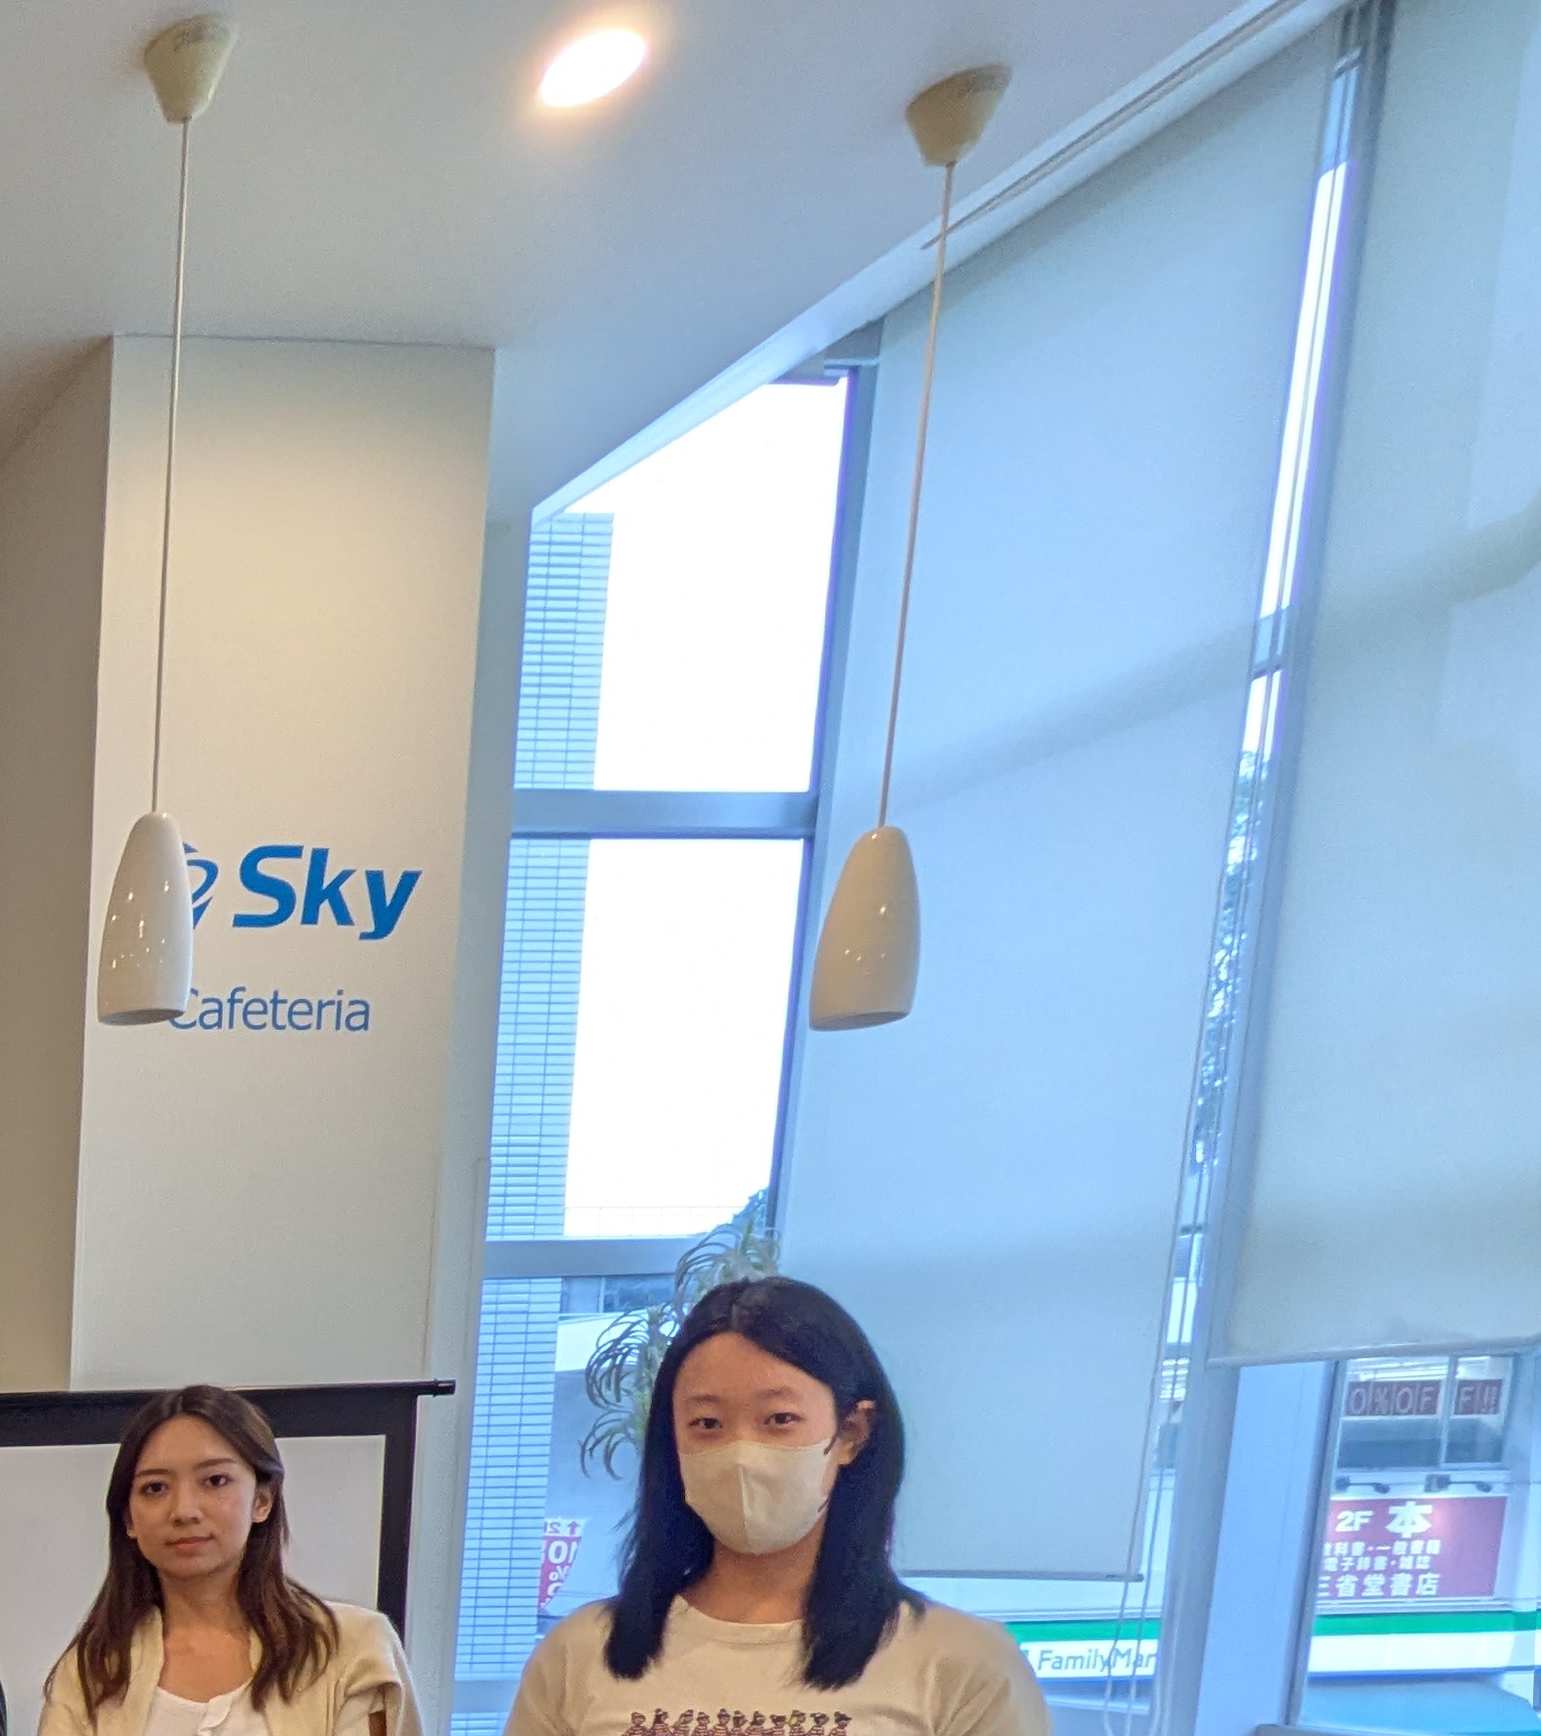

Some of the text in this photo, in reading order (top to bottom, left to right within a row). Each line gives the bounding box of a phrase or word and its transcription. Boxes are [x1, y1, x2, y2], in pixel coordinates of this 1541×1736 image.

[232, 844, 423, 941] Sky
[1335, 1501, 1433, 1538] 2F 本
[1037, 1647, 1158, 1673] FamilyMar
